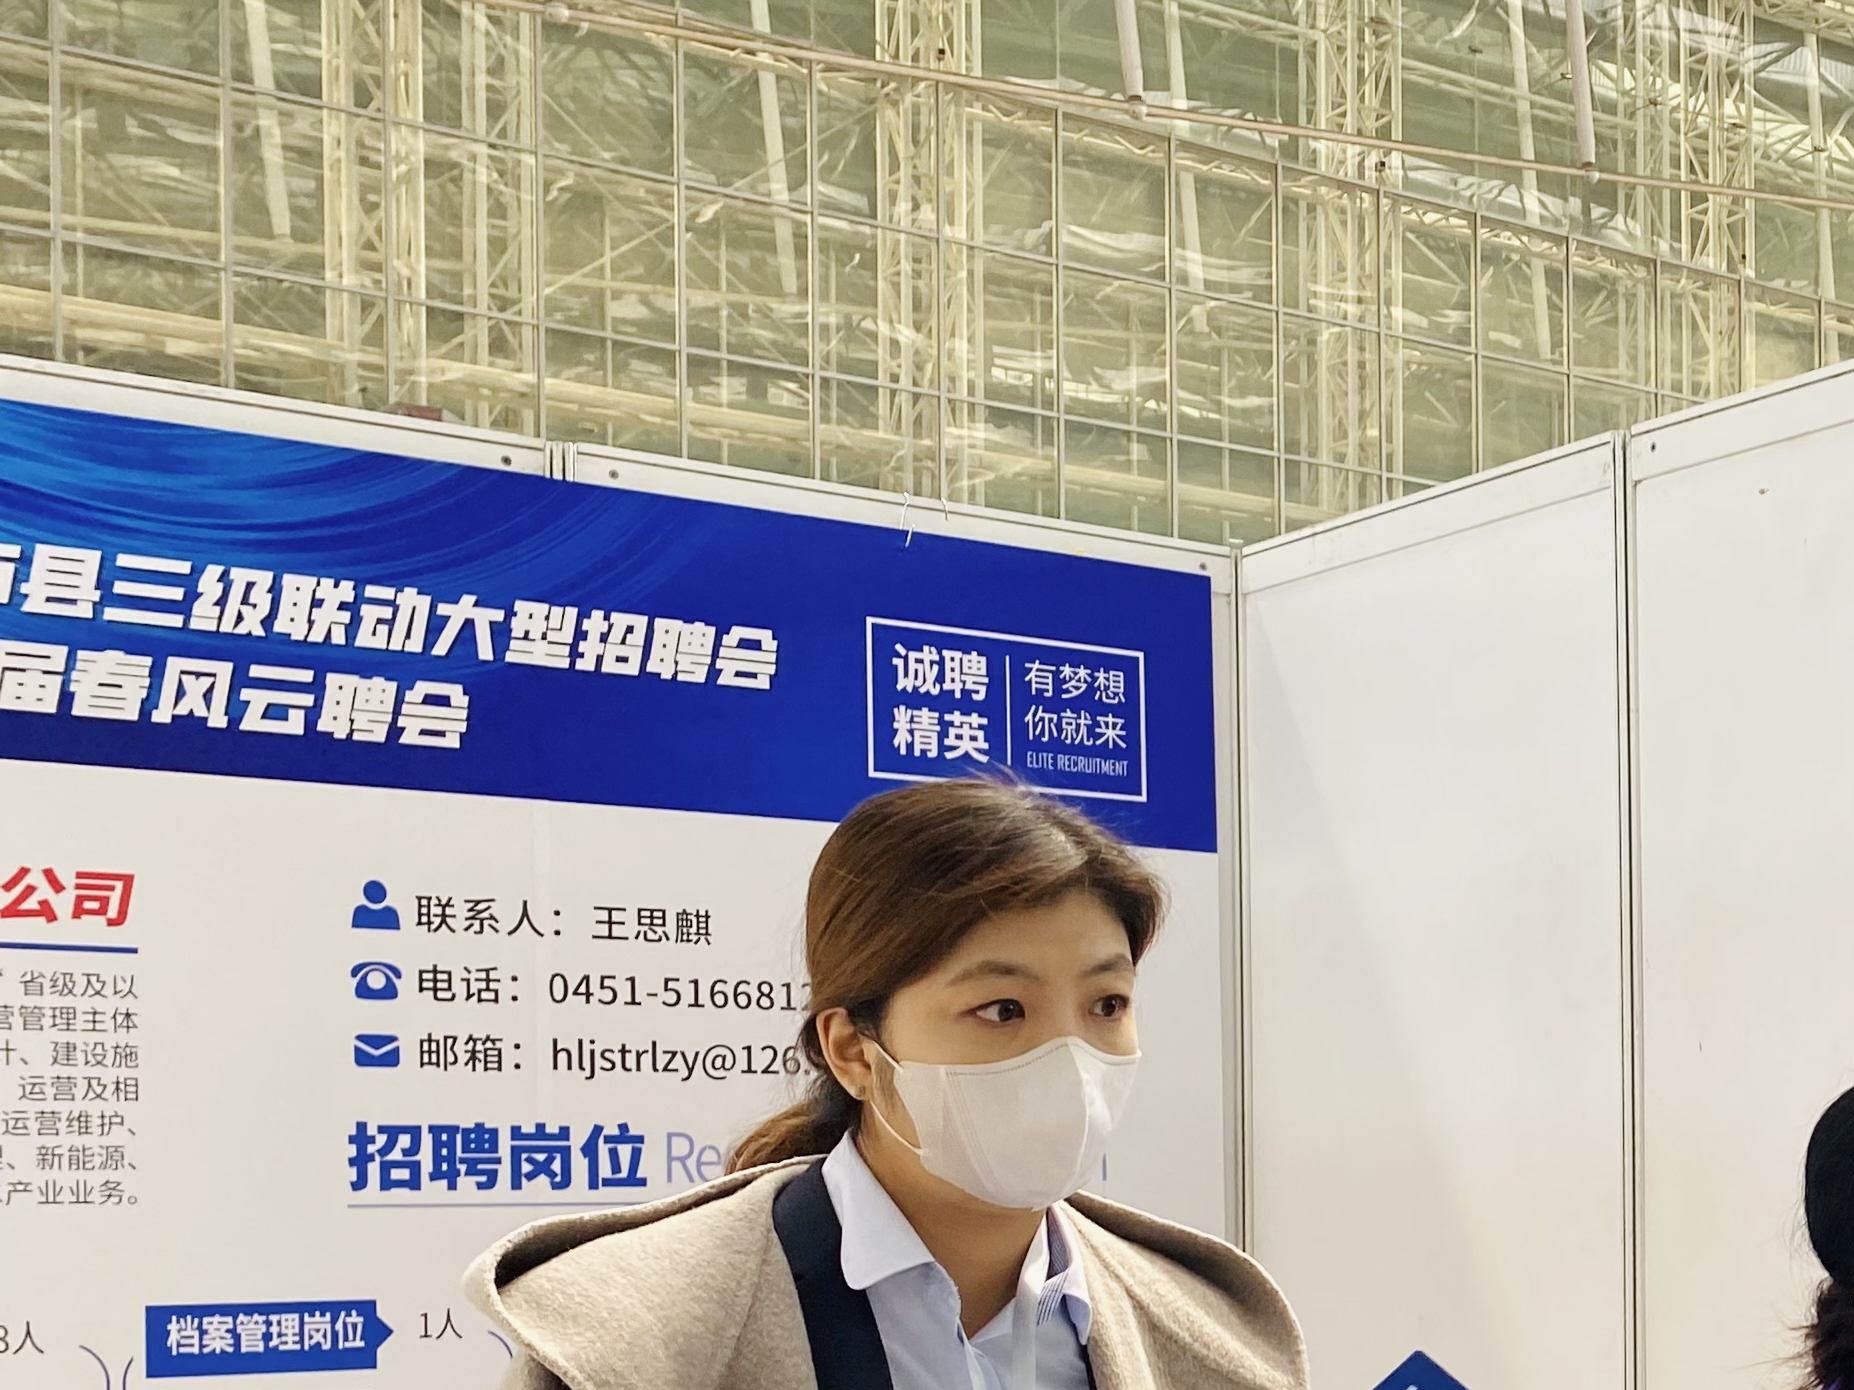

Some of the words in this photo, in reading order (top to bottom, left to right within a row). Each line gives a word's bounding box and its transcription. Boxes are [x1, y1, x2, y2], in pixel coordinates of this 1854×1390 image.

[0, 638, 470, 749] 届春风云聘会
[892, 643, 990, 701] 诚聘
[1024, 659, 1126, 704] 有梦想
[892, 704, 990, 764] 精英
[1024, 704, 1127, 750] 你就来
[1027, 751, 1054, 770] ELITE
[1057, 754, 1129, 777] RECRUITMENT
[0, 866, 136, 928] 公司
[18, 1075, 139, 1102] 运营及相
[1, 1110, 137, 1137] 运营维护、
[0, 1144, 137, 1171] 、新能源、
[347, 1121, 648, 1191] 招聘岗位
[666, 1131, 728, 1184] Re
[165, 1309, 366, 1356] 档案管理岗位
[418, 1307, 464, 1341] 1人
